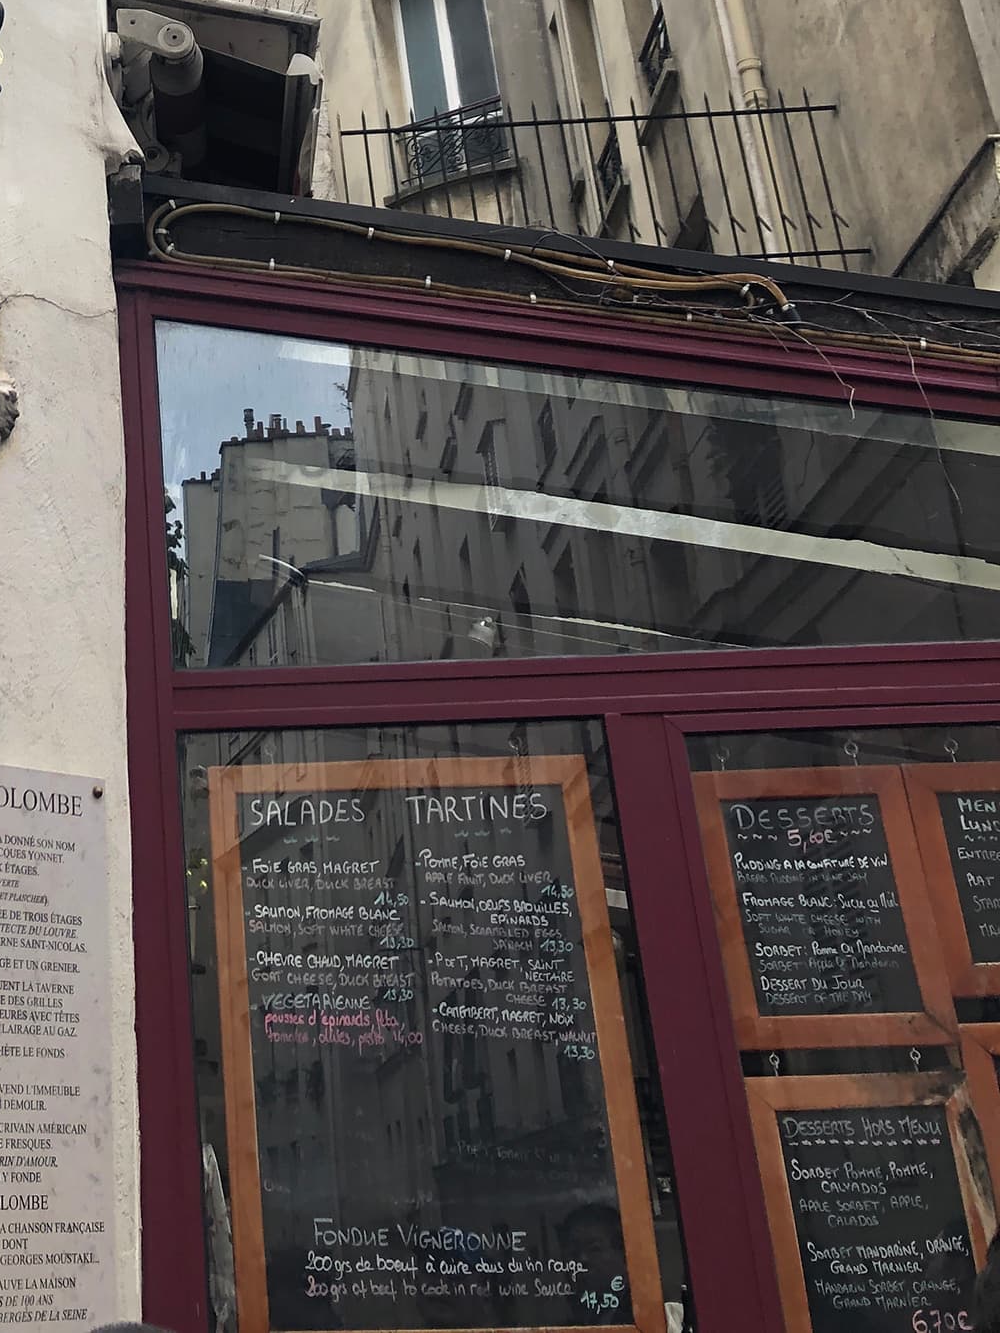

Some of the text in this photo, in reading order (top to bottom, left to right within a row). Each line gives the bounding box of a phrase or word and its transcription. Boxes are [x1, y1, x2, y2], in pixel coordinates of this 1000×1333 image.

[251, 799, 366, 826] SALADES
[405, 791, 547, 824] TARTINES
[730, 804, 874, 829] DESSERTS
[324, 860, 380, 874] MAGRET
[493, 855, 525, 867] GRAS
[375, 891, 408, 907] 14,50
[541, 885, 574, 899] 14,50
[743, 892, 794, 907] FROMAGE
[306, 906, 353, 920] FROMAGE
[359, 907, 400, 920] BLANC
[345, 954, 399, 969] MAGRET
[760, 975, 864, 991] DESSERT DU JOUR
[783, 1116, 941, 1139] DESSERTS HORS MENU
[791, 1158, 934, 1180] SORBET POMME,
[1, 1172, 8, 1183] Y
[10, 1172, 41, 1183] FONDE
[821, 1181, 887, 1194] CALVADOS
[7, 1223, 53, 1235] CHANSON
[55, 1222, 105, 1236] FRANÇAISE
[314, 1218, 388, 1247] FONDUE
[1, 1239, 28, 1251] DONT
[807, 1241, 852, 1262] SORBET
[426, 1255, 436, 1273] à
[548, 1259, 588, 1283] rouge
[831, 1260, 922, 1276] GRAND MARNIER
[581, 1290, 619, 1314] 17,50
